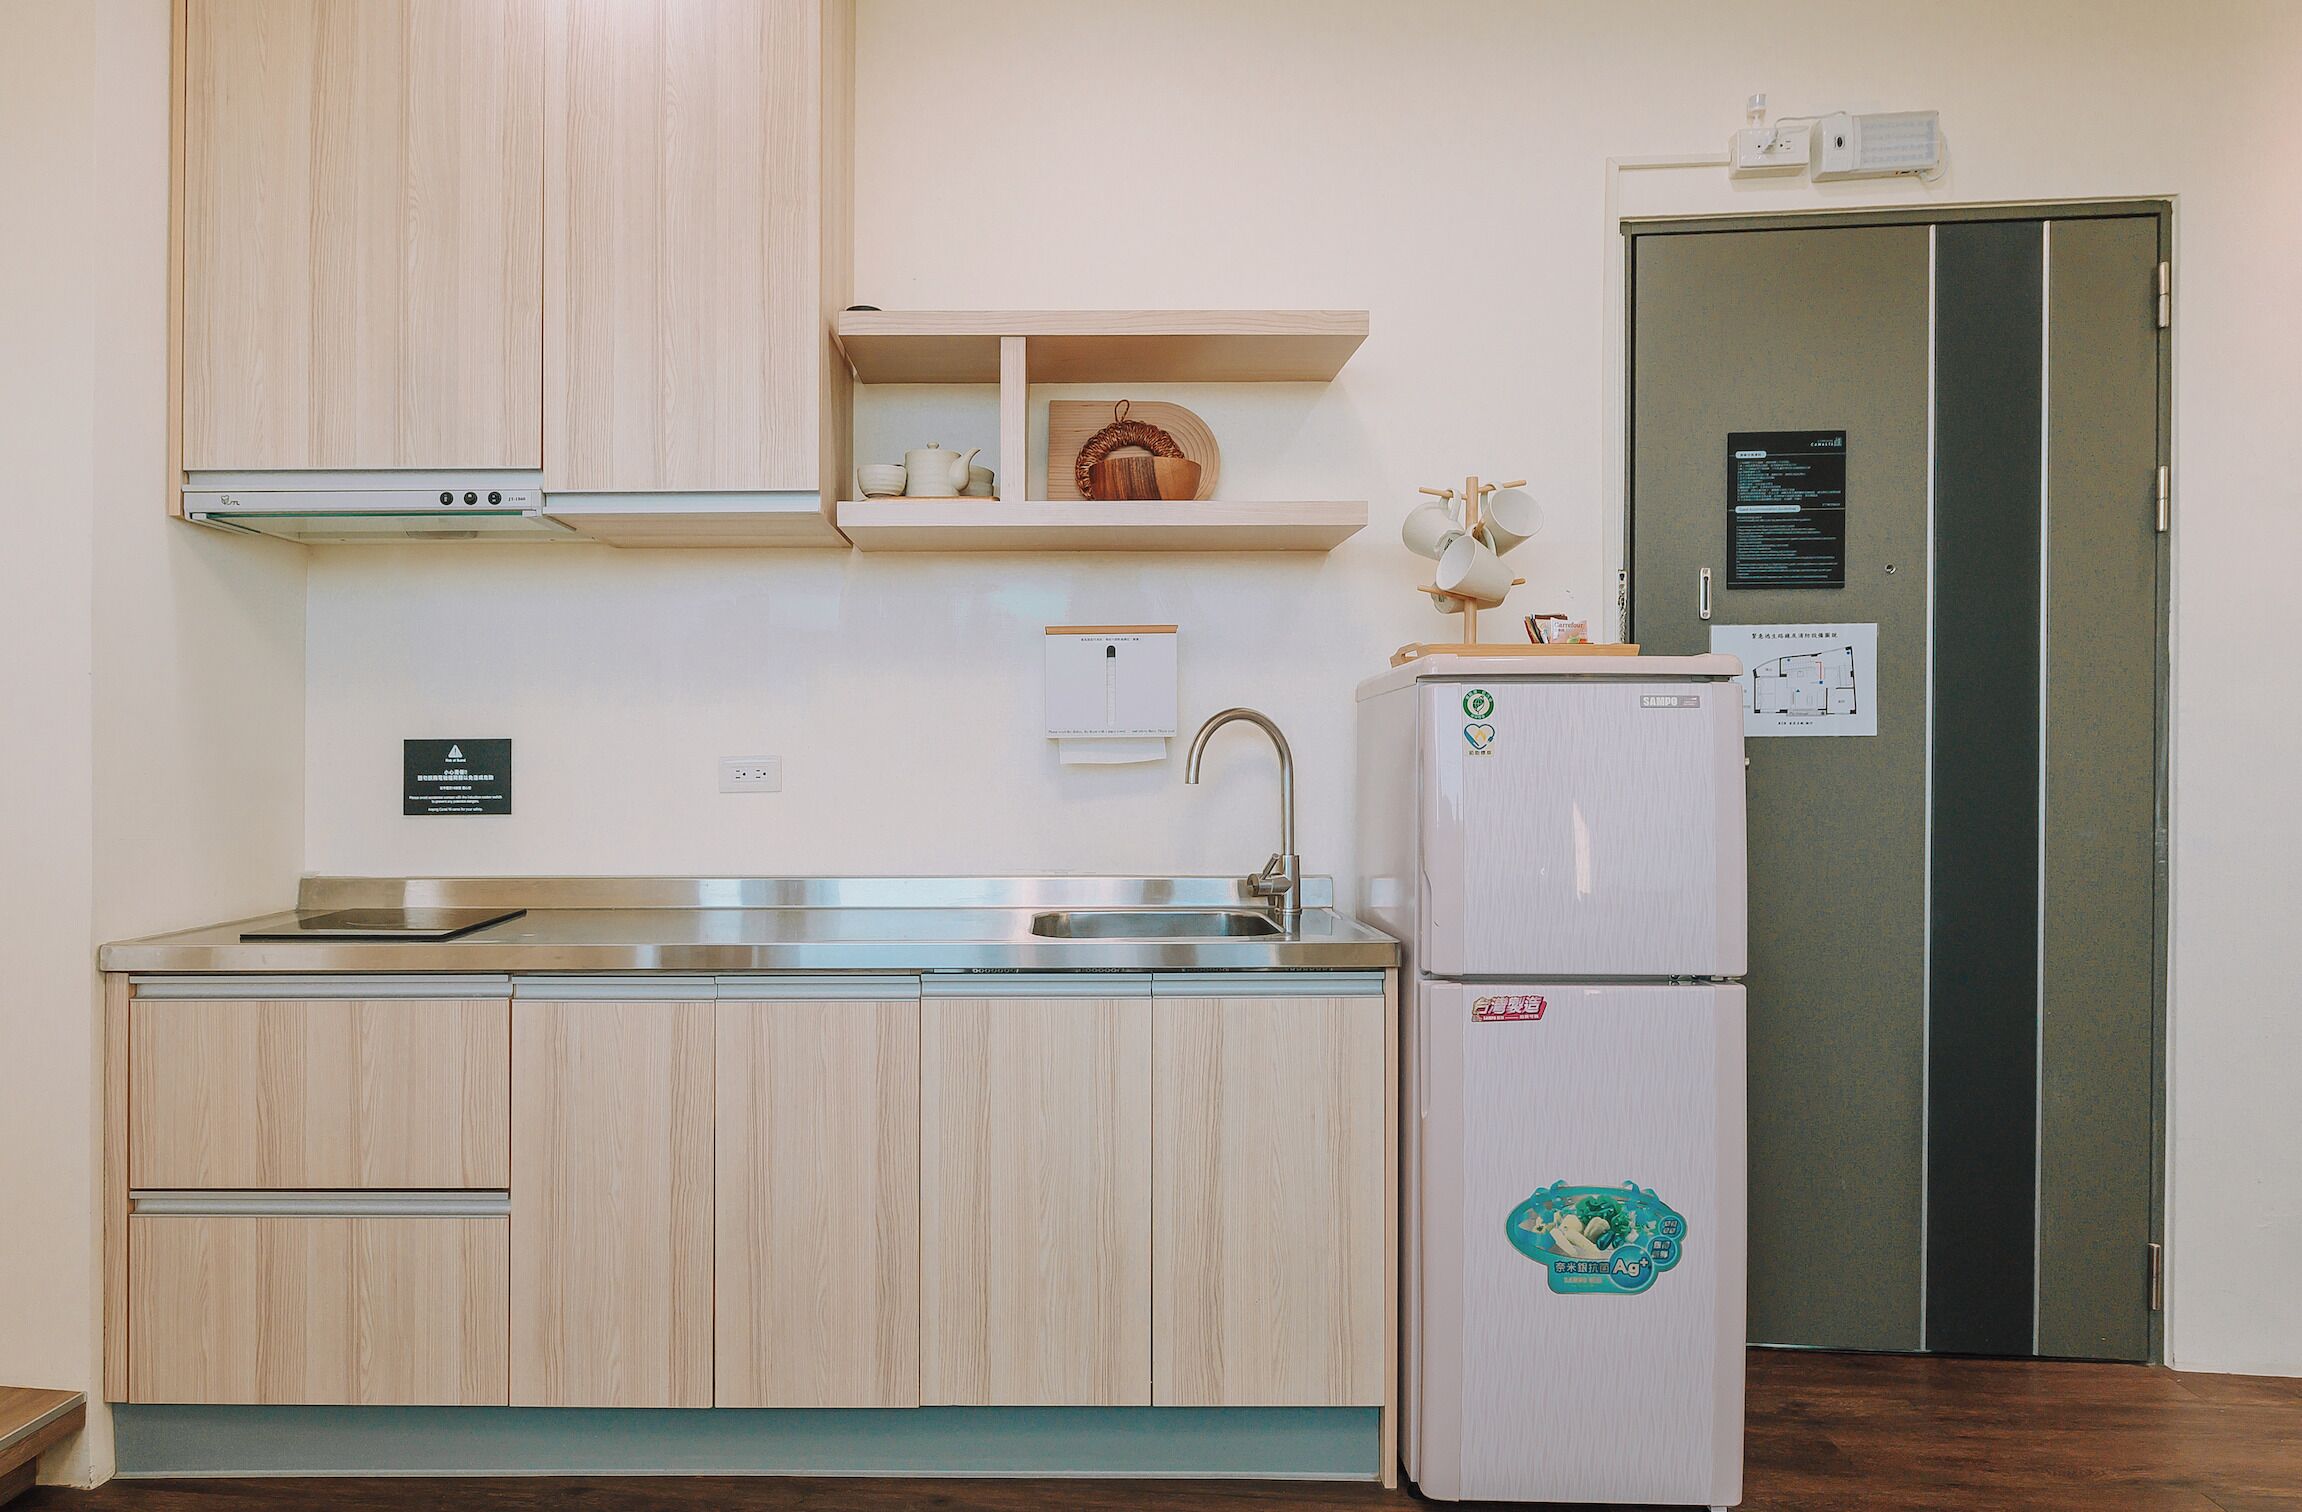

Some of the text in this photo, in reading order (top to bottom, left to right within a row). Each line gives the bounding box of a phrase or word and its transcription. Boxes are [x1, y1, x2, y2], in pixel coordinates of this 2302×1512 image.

[1643, 696, 1678, 706] SAMPO
[1474, 996, 1543, 1015] 台灣製造
[1554, 1261, 1610, 1274] 奈米銀抗菌
[1612, 1257, 1649, 1277] Ag+
